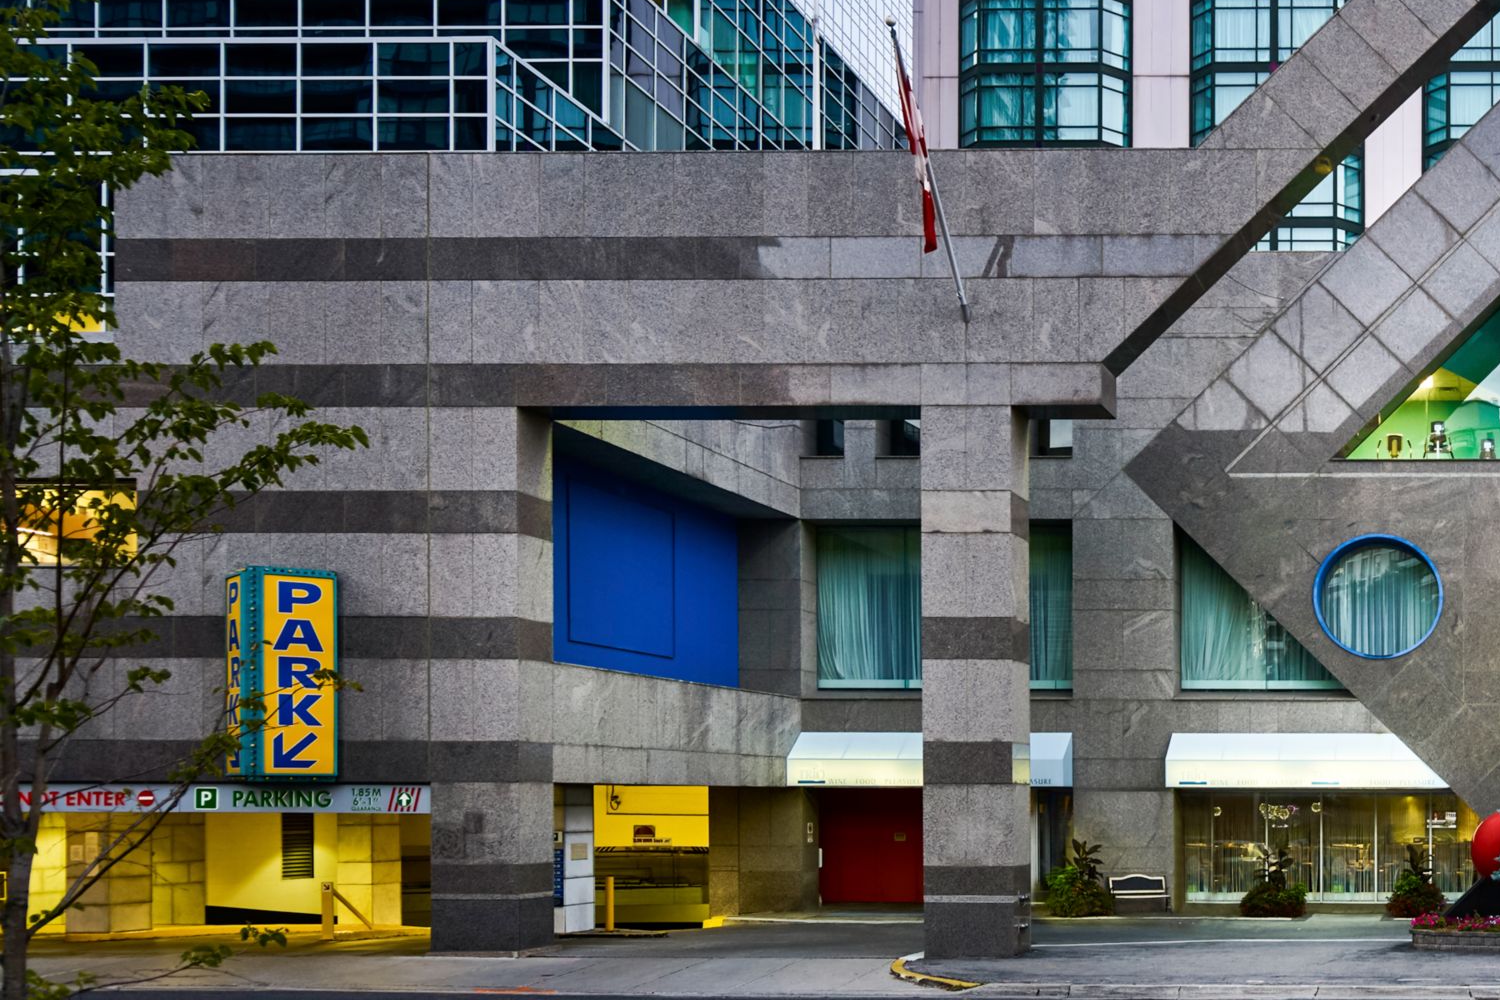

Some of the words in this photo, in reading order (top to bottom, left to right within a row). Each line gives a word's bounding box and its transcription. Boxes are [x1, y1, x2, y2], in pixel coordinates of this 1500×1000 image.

[228, 581, 240, 725] PARK
[273, 581, 324, 726] PARK
[65, 791, 126, 806] ENTER
[232, 790, 333, 808] PARKING
